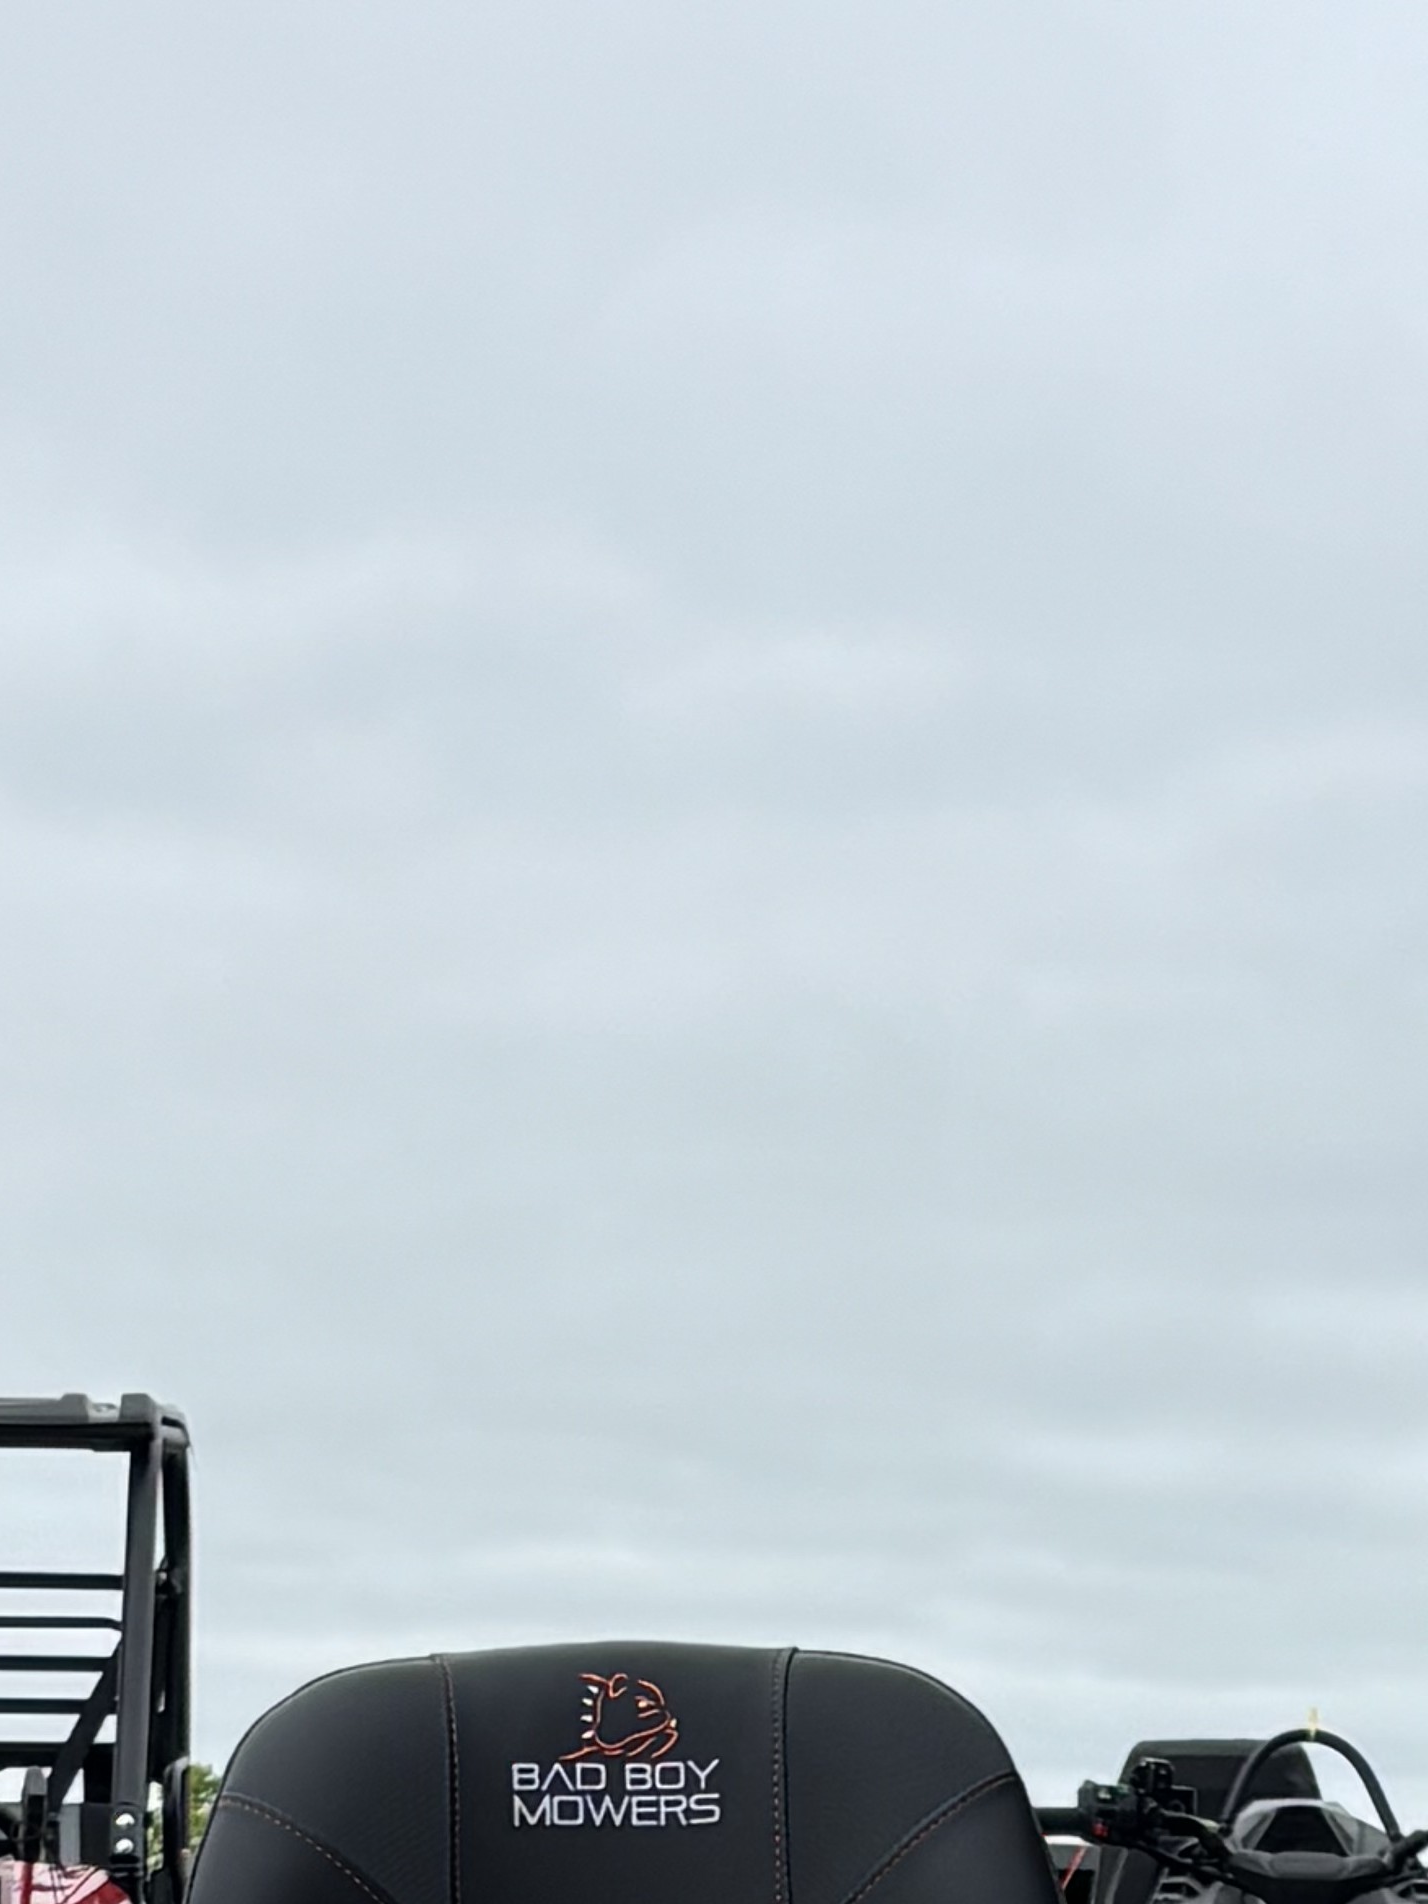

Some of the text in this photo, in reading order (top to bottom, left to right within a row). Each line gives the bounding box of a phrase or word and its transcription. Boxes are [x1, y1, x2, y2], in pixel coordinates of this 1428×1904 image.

[511, 1759, 720, 1791] BAD BOY
[513, 1793, 721, 1827] MOWERS
